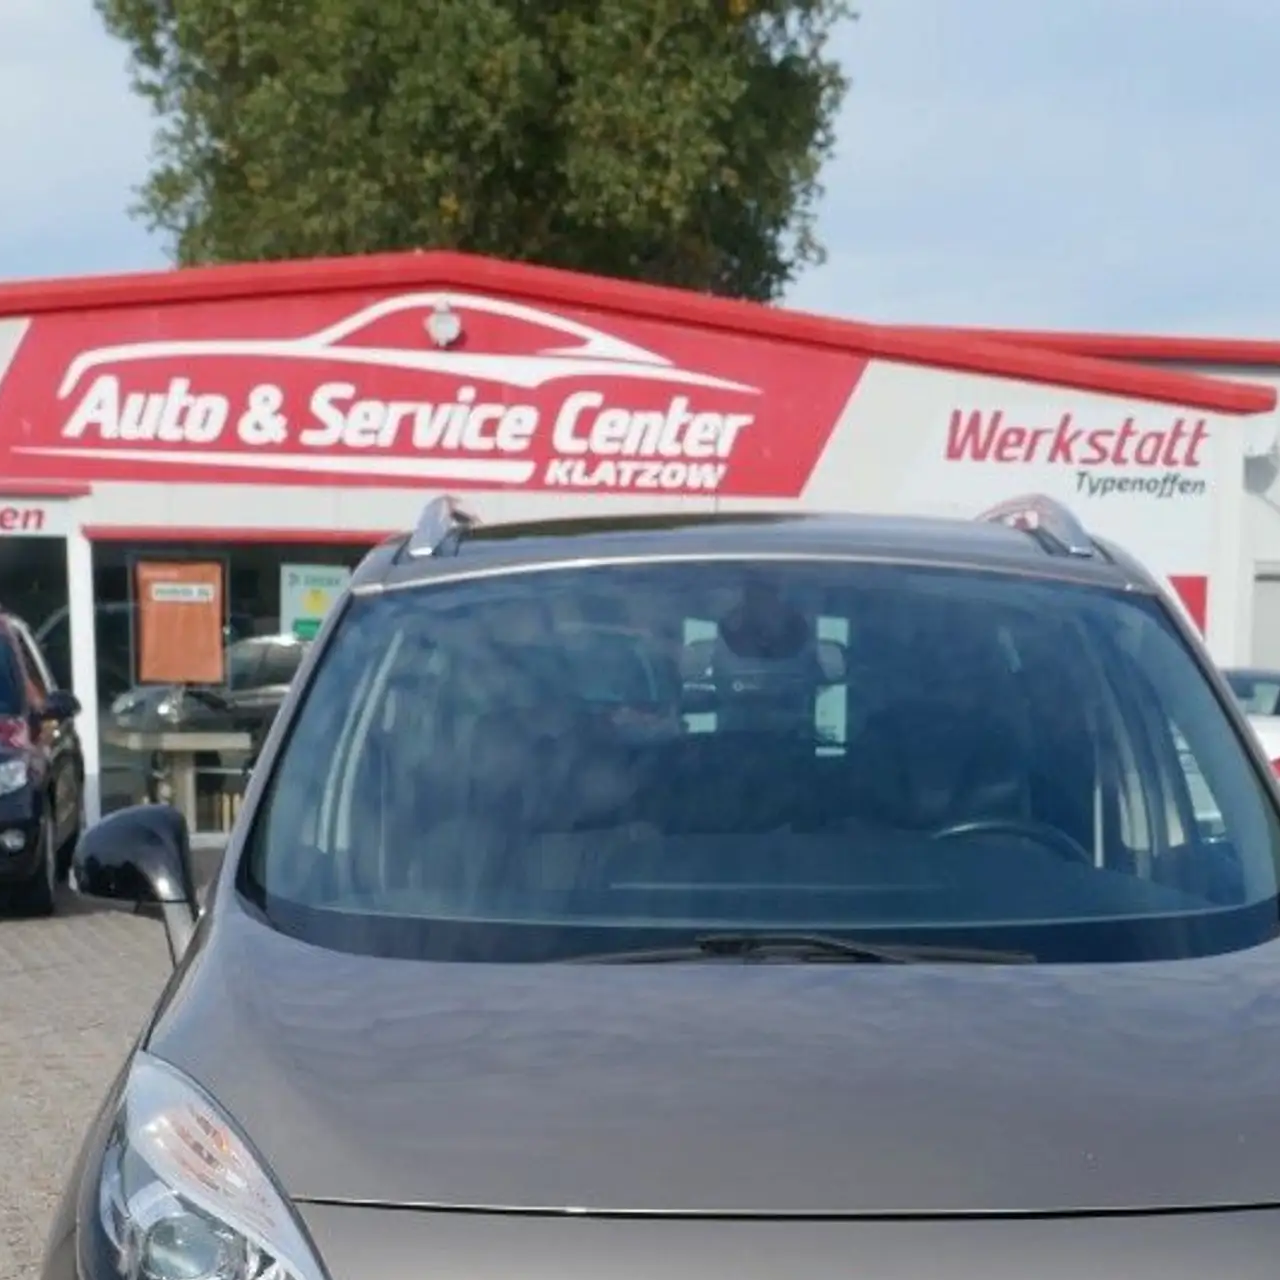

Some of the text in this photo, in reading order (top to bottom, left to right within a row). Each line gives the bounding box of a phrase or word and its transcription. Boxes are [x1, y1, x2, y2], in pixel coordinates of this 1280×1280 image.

[62, 375, 754, 459] Auto & Service Center
[945, 409, 1210, 467] Werkstatt
[544, 457, 727, 490] KLATZOW
[1075, 471, 1206, 498] Typenoffen
